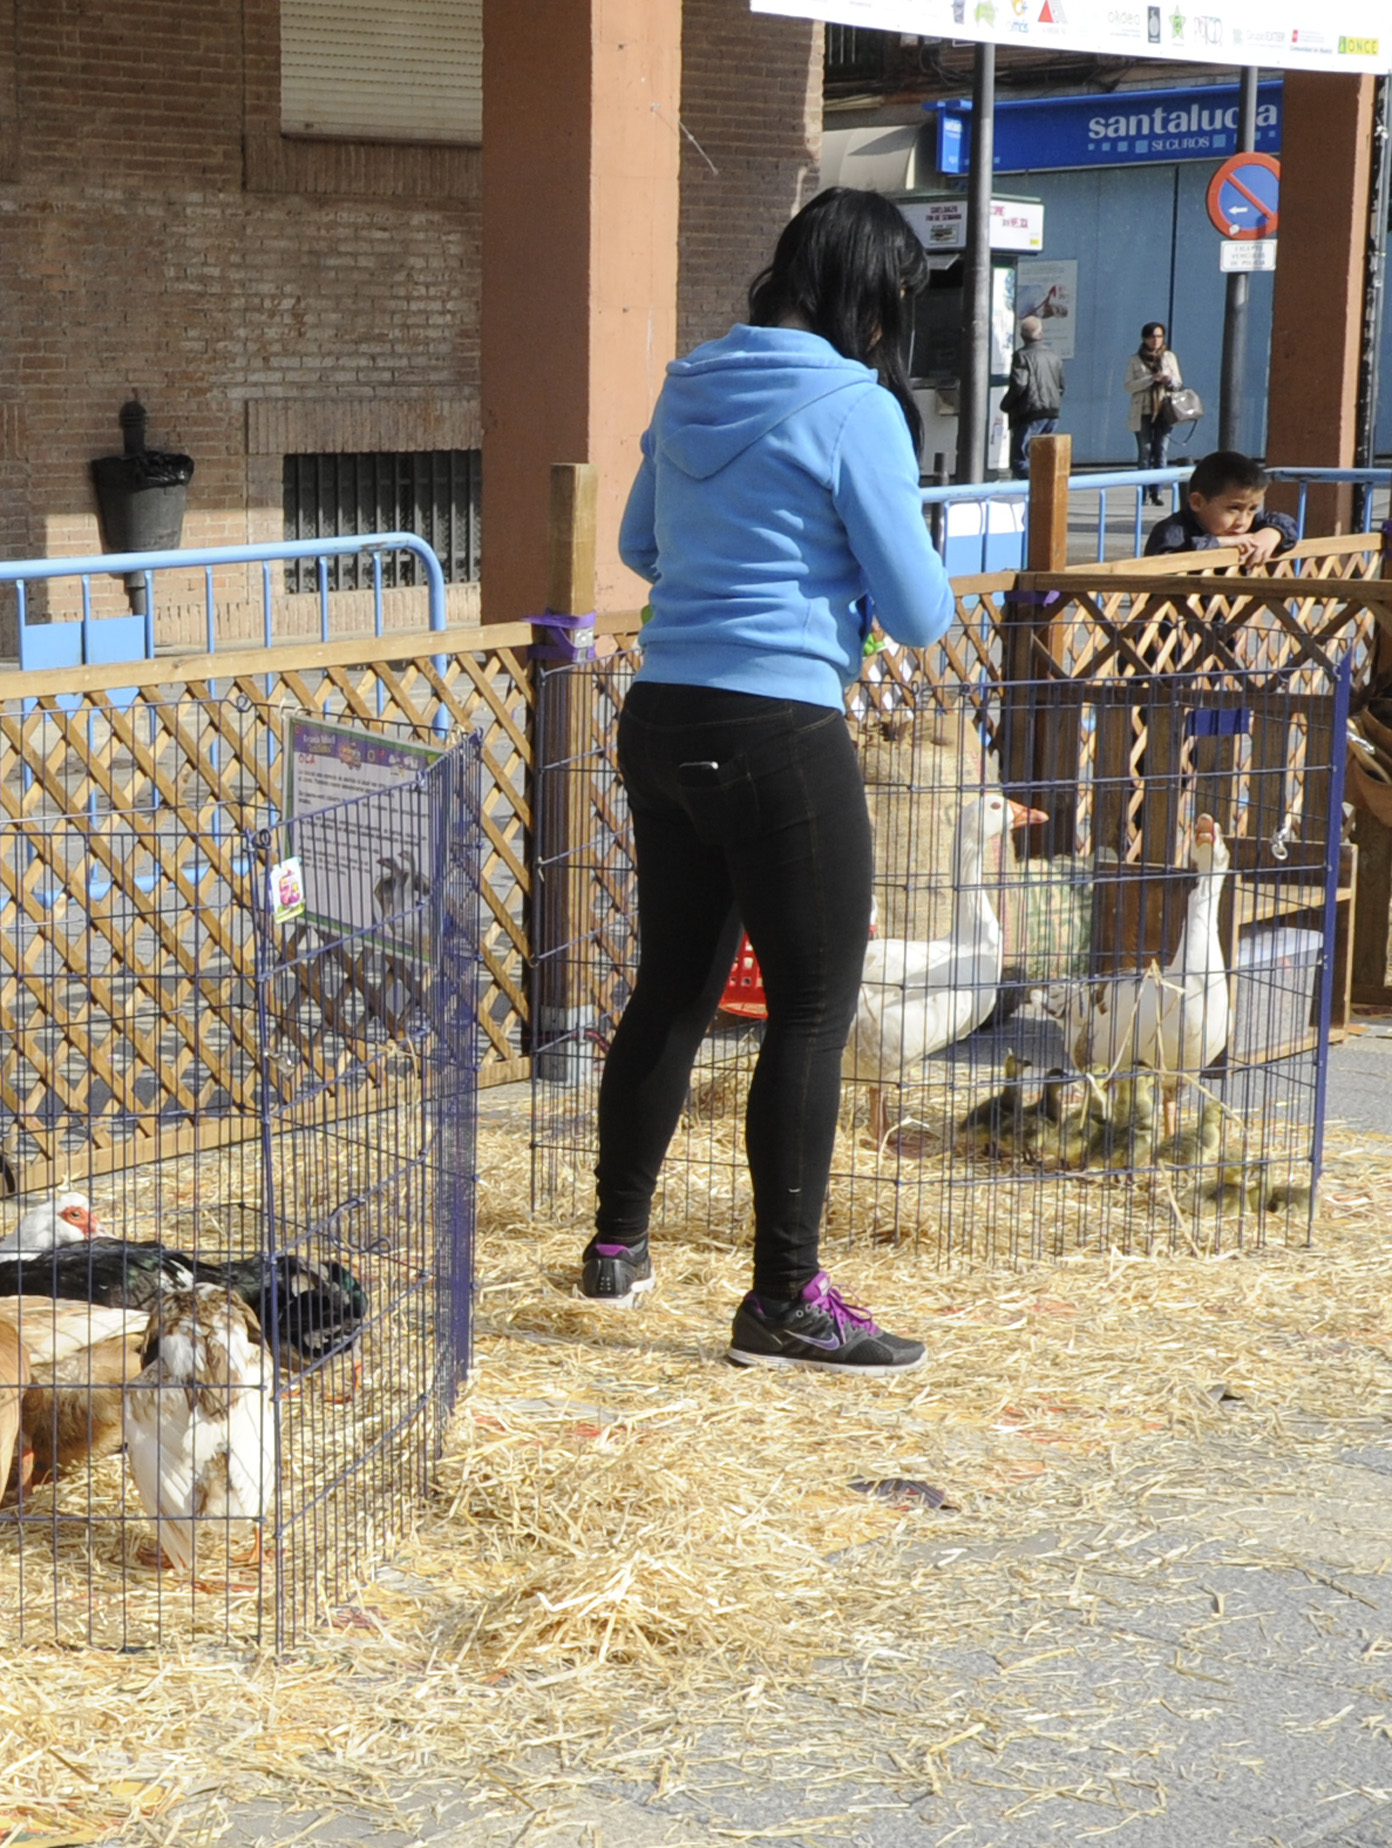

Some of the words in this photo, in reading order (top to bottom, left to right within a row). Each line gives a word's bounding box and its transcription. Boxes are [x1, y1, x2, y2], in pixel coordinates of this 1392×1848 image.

[1348, 39, 1377, 55] ONCE
[1088, 104, 1277, 139] santaluca
[1151, 137, 1210, 151] SEGUROS
[298, 753, 315, 764] OCA
